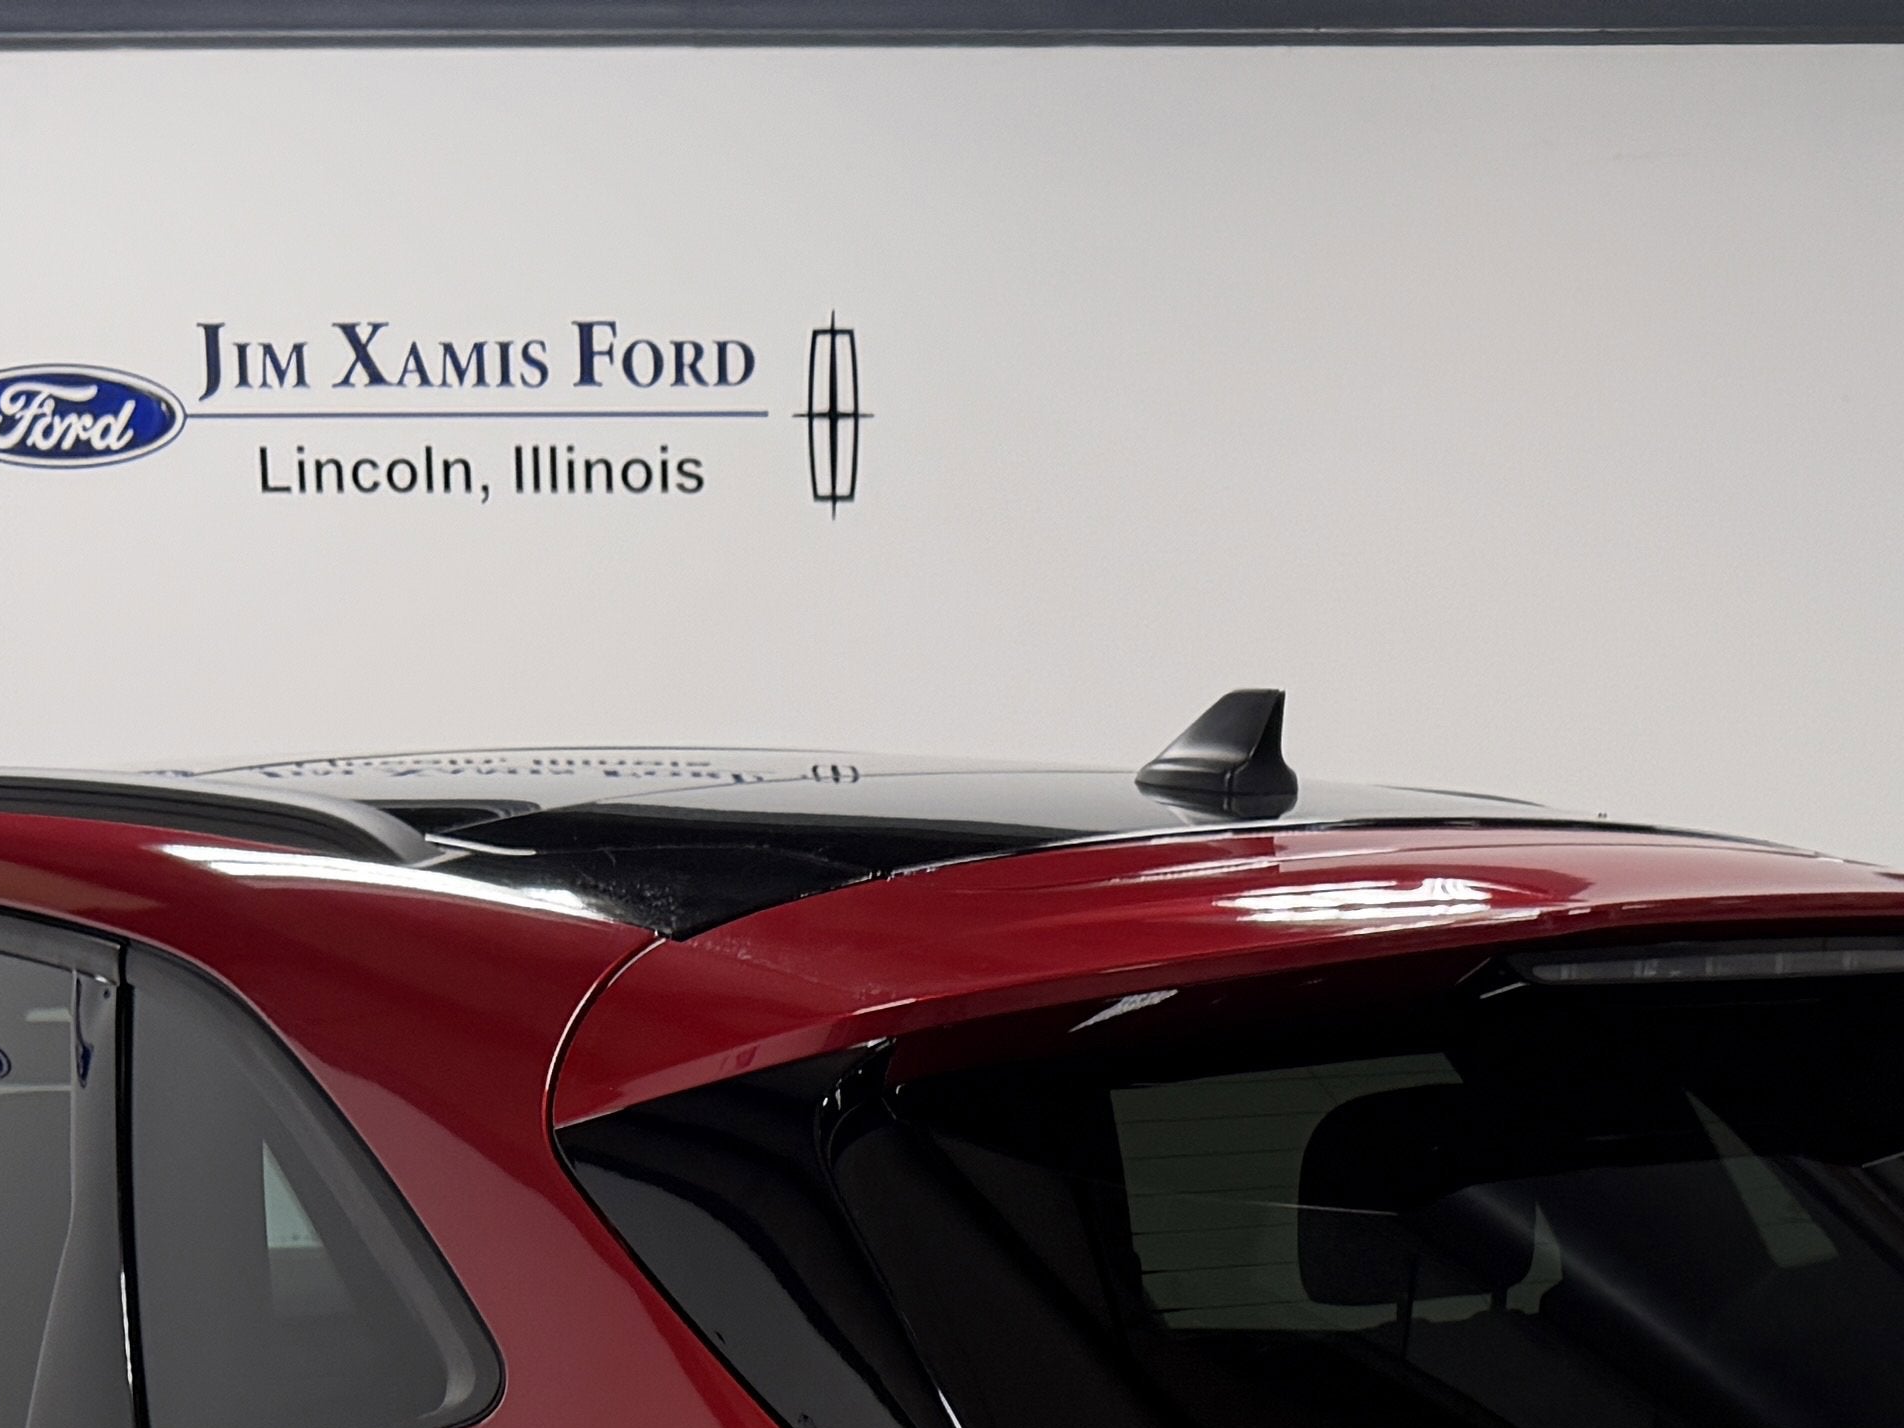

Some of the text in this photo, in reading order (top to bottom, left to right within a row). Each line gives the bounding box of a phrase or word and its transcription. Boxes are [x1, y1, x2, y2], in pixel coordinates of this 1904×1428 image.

[197, 320, 756, 402] JIM XAMIS FORD
[258, 443, 705, 504] Lincoln, Illinois
